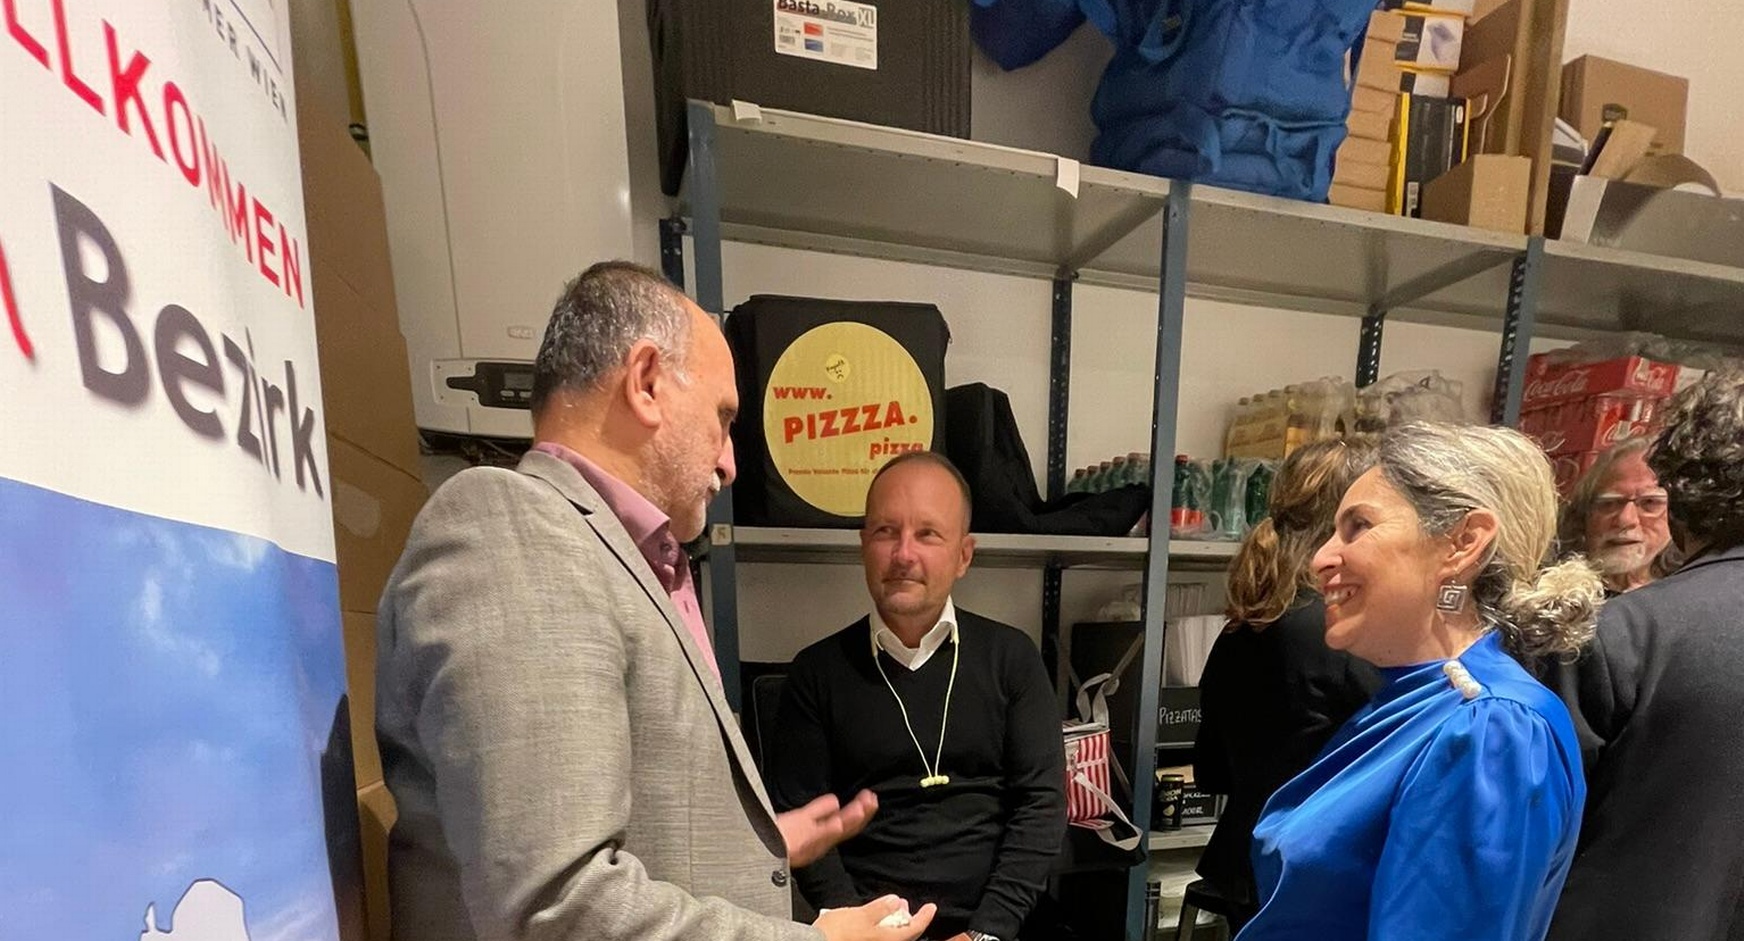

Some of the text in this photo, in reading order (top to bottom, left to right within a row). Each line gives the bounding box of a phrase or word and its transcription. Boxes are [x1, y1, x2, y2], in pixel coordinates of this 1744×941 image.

[858, 6, 875, 28] XL
[49, 181, 323, 500] Bezirk
[773, 387, 832, 399] www.
[784, 401, 918, 444] PIZZZA.
[870, 437, 923, 460] pizza
